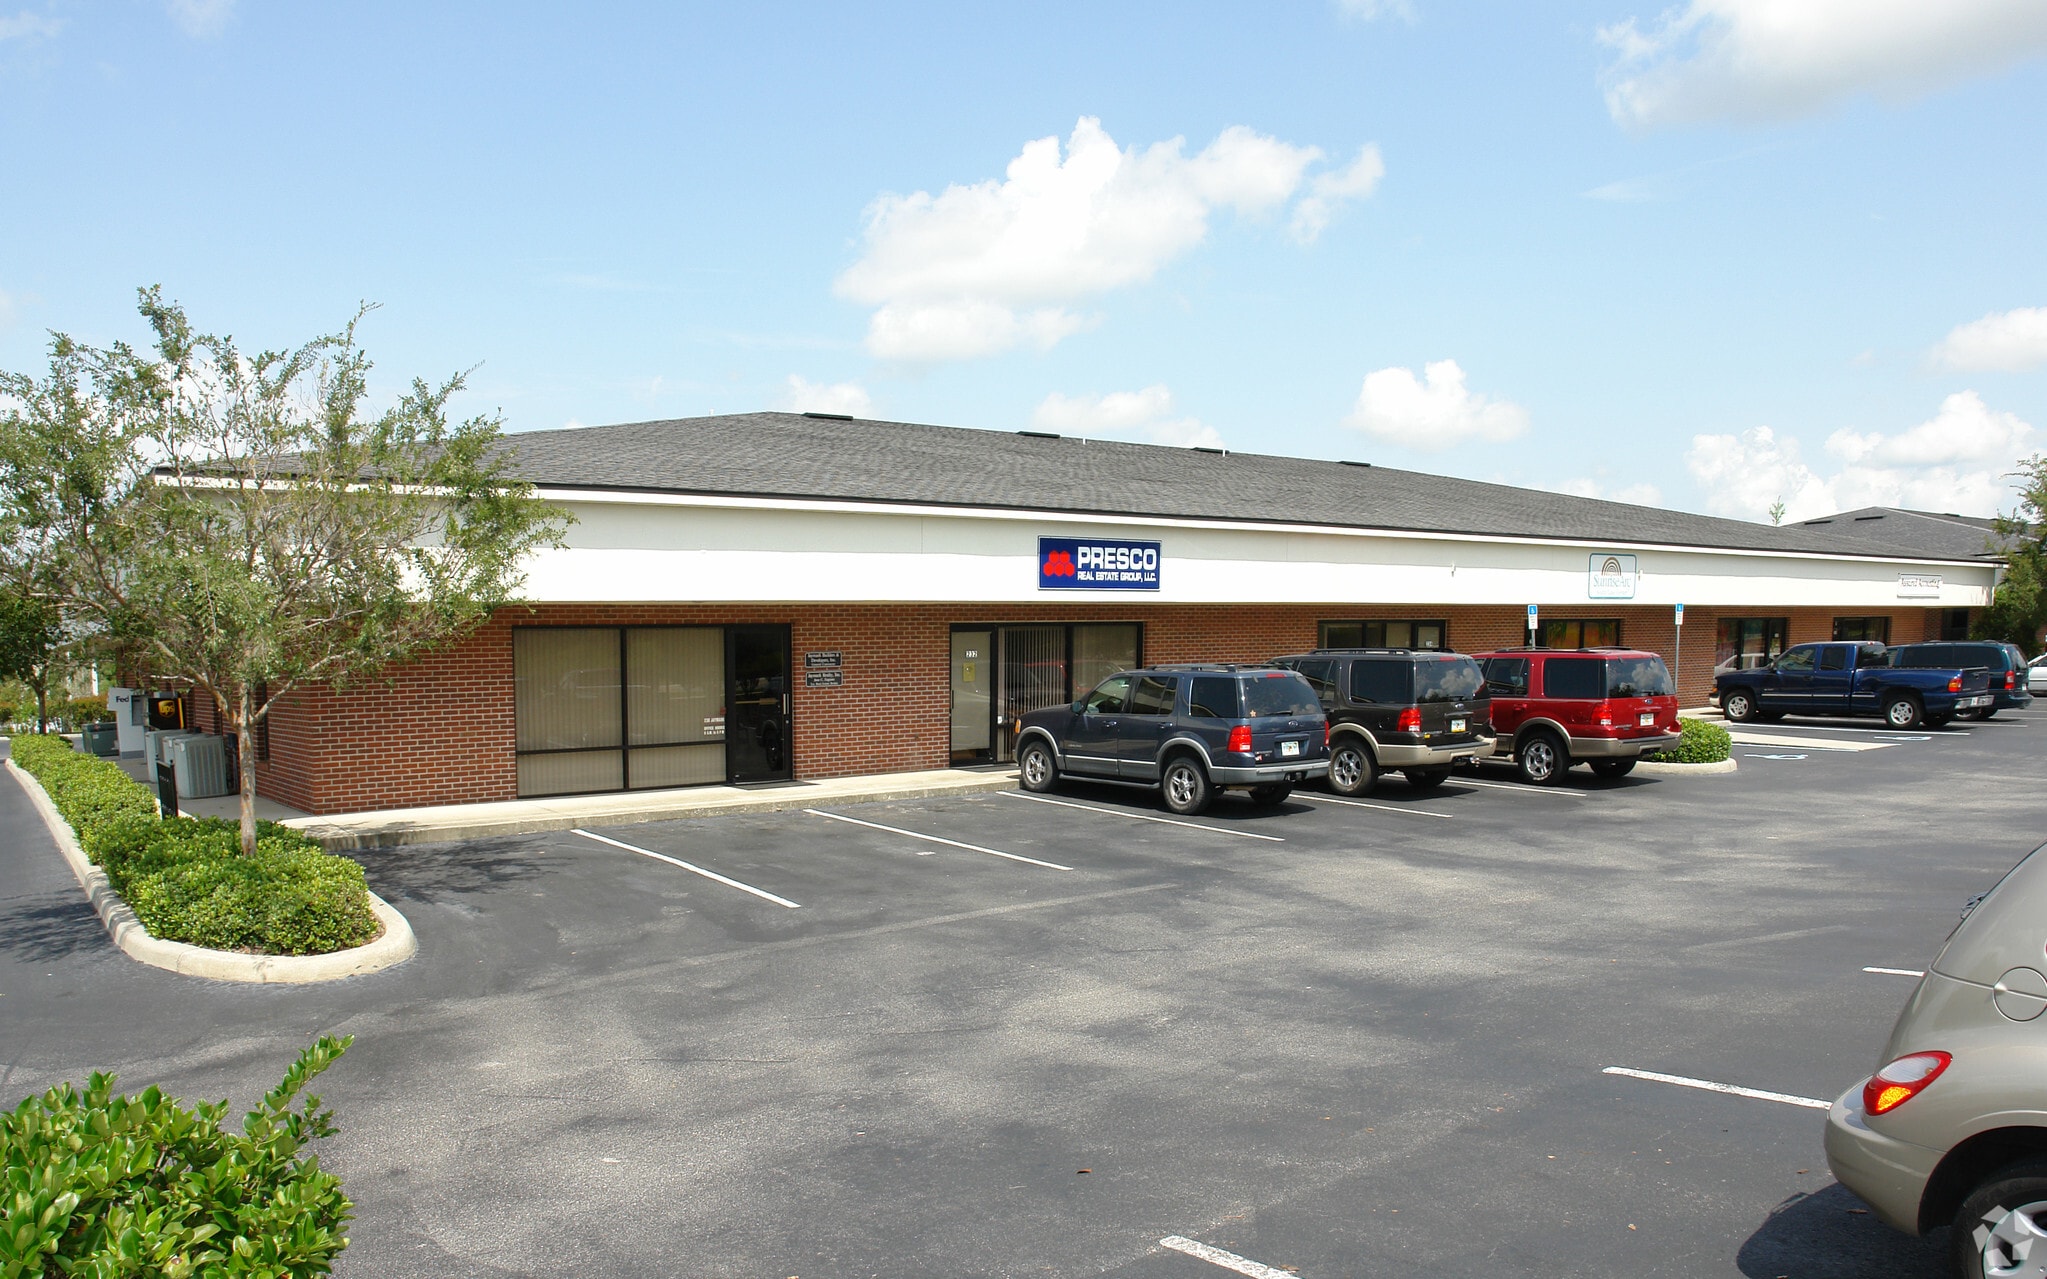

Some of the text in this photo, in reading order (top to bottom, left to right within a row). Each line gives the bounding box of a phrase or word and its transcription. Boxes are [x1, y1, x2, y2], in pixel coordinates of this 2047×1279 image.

[1077, 546, 1157, 571] PRESCO
[1077, 571, 1094, 581] REAL
[1096, 571, 1119, 581] ESTATE
[1120, 572, 1143, 583] GROUP,
